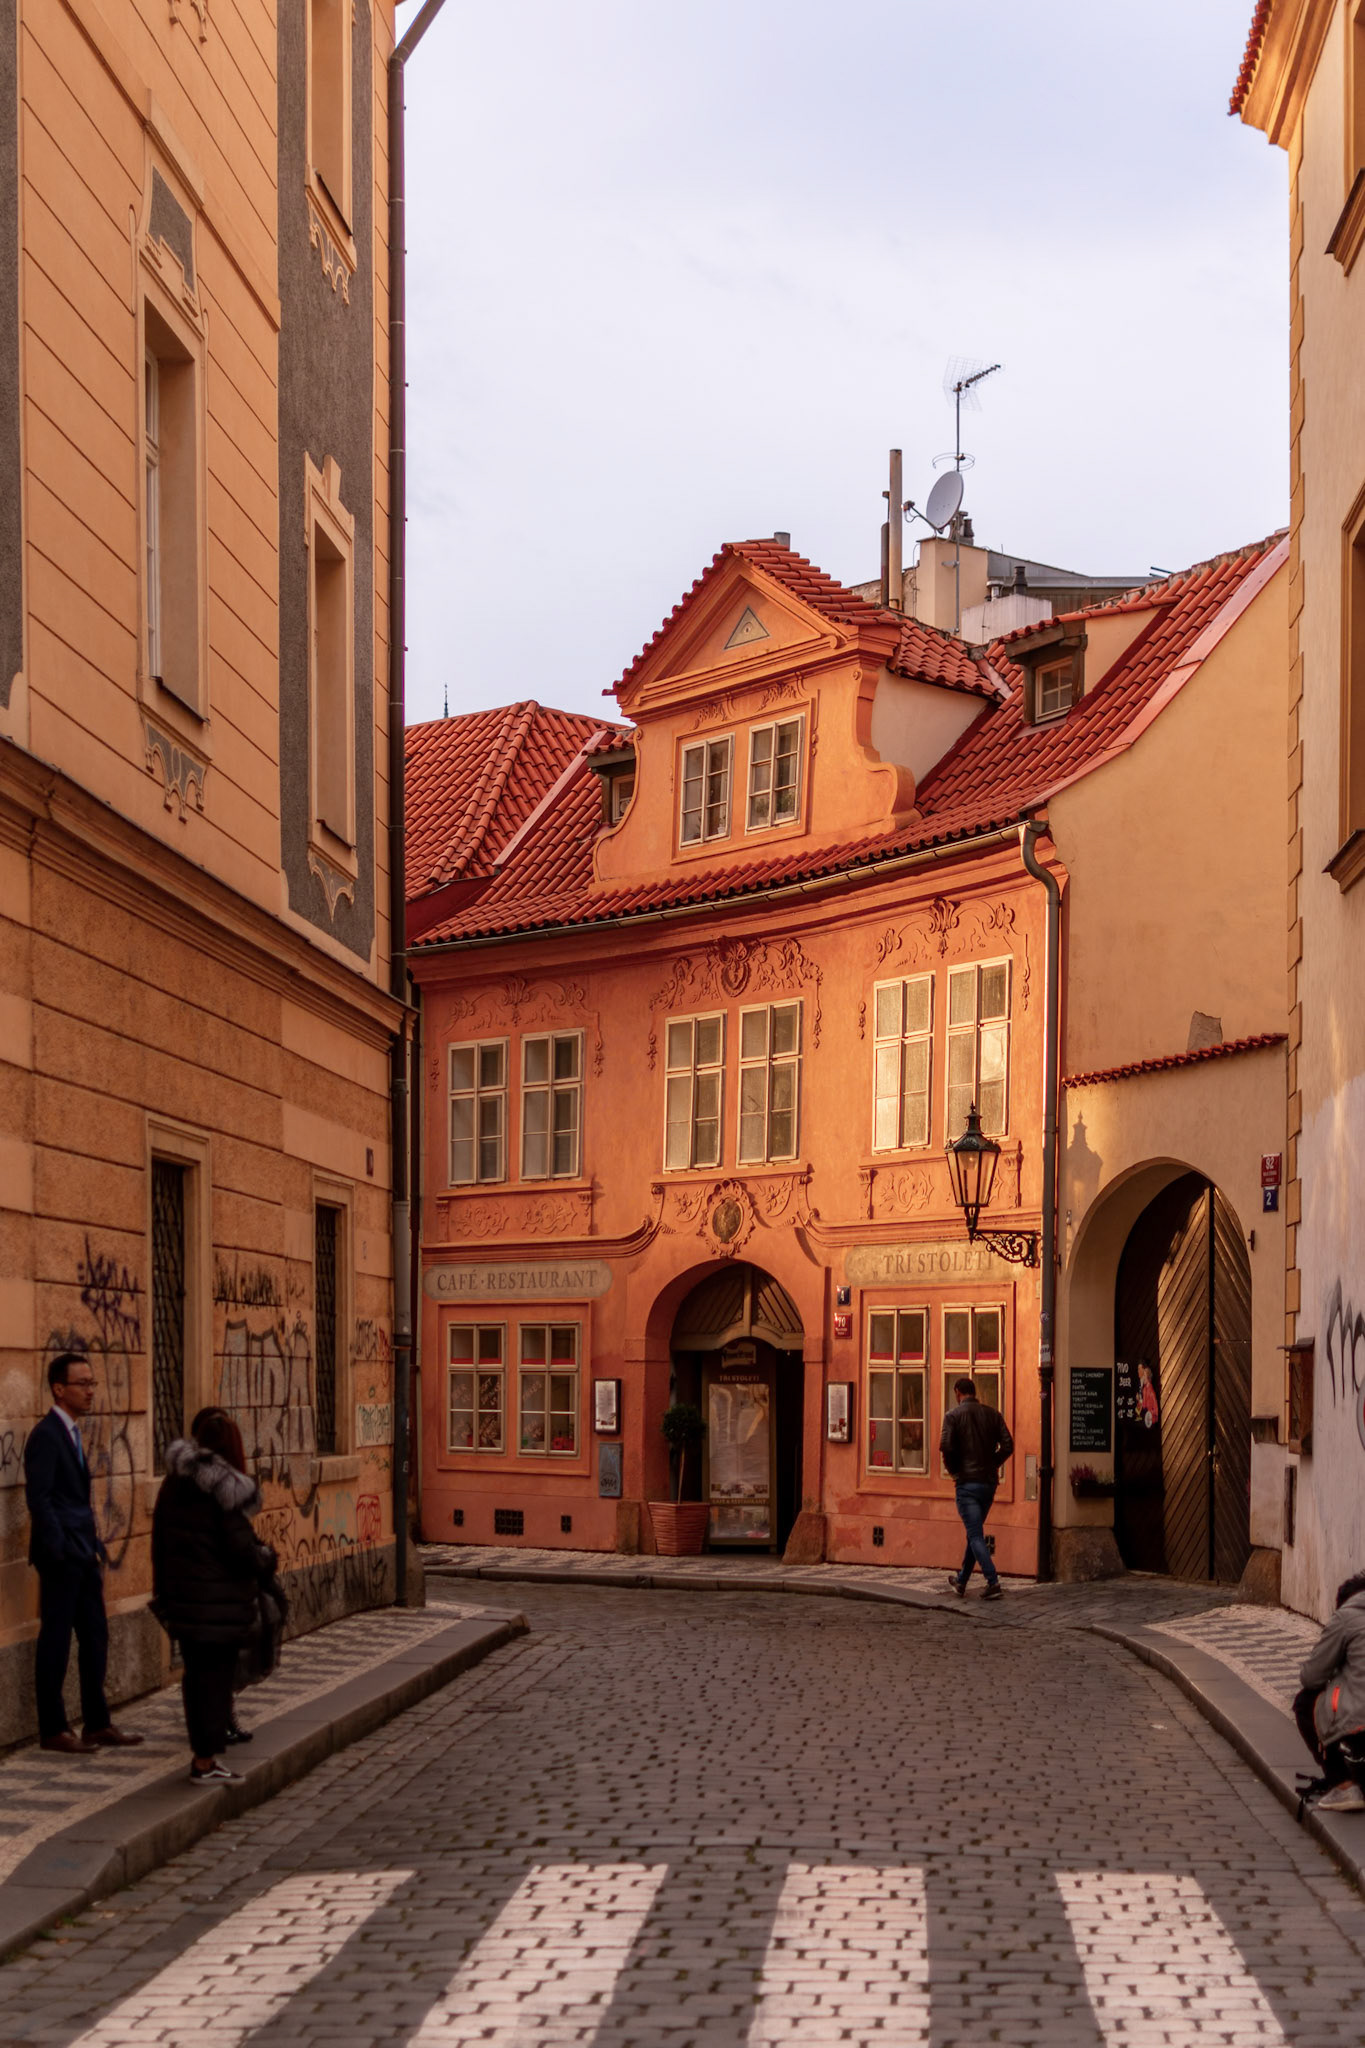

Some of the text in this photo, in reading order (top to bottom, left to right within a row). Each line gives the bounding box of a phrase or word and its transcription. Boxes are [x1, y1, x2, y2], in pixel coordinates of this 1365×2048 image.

[1266, 1191, 1272, 1206] 2
[437, 1269, 598, 1291] CAFÉ RESTAURANT
[1117, 1362, 1129, 1374] PIVO
